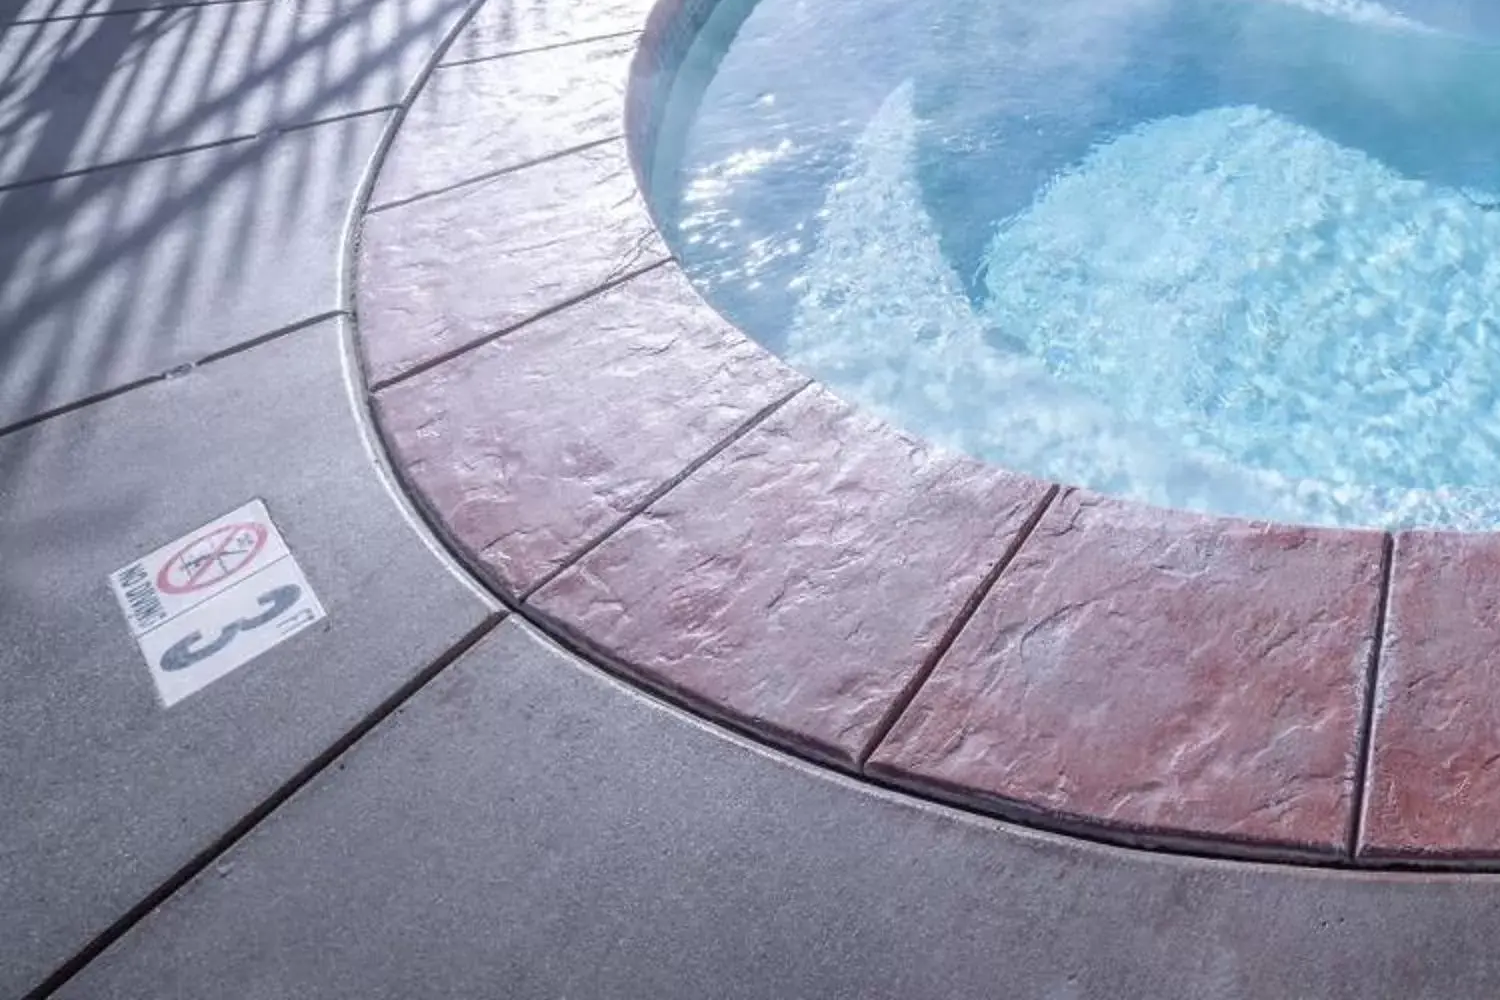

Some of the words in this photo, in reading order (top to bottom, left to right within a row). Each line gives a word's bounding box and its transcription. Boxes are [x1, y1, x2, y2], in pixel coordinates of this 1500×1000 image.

[118, 562, 148, 588] NO
[125, 581, 167, 628] DIVING
[159, 583, 302, 673] 3
[275, 607, 315, 636] FT
